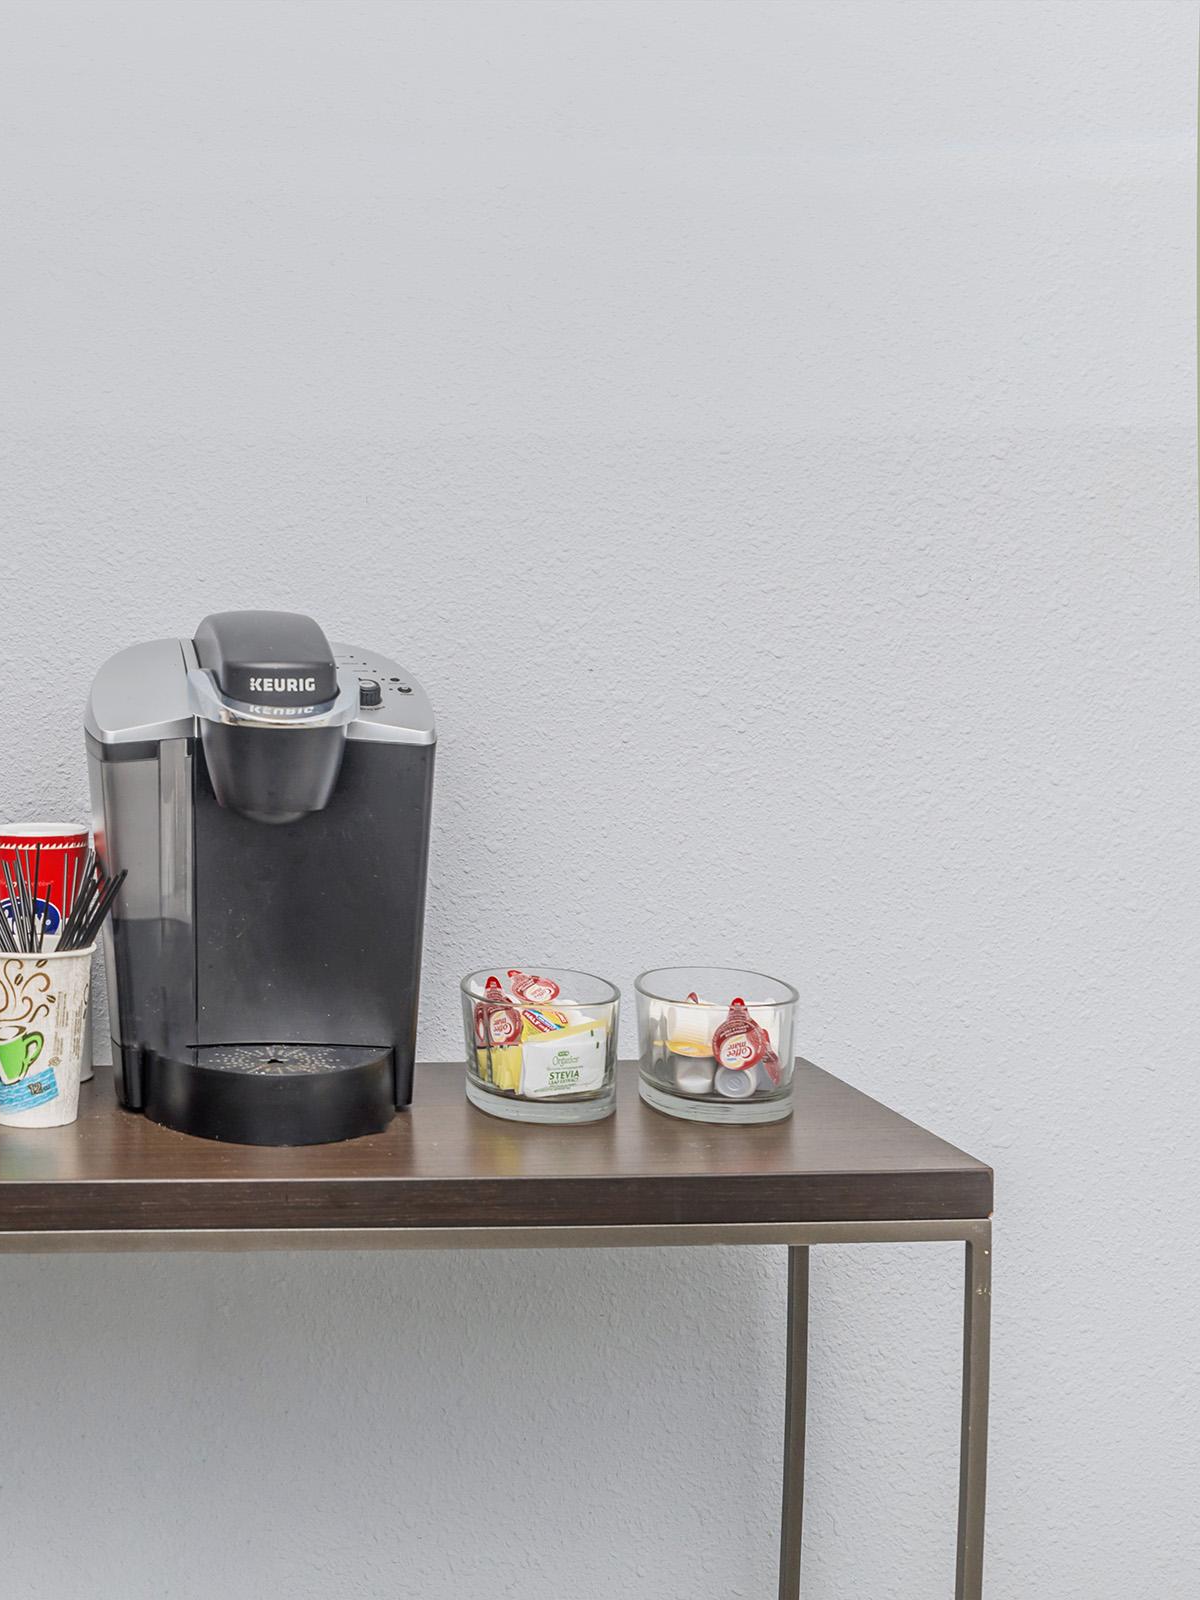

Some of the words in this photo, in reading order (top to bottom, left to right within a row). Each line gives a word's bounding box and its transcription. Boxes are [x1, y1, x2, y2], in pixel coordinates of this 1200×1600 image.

[249, 677, 315, 692] KEURIG
[726, 1046, 752, 1059] Coffee
[550, 1070, 579, 1080] STEVIA
